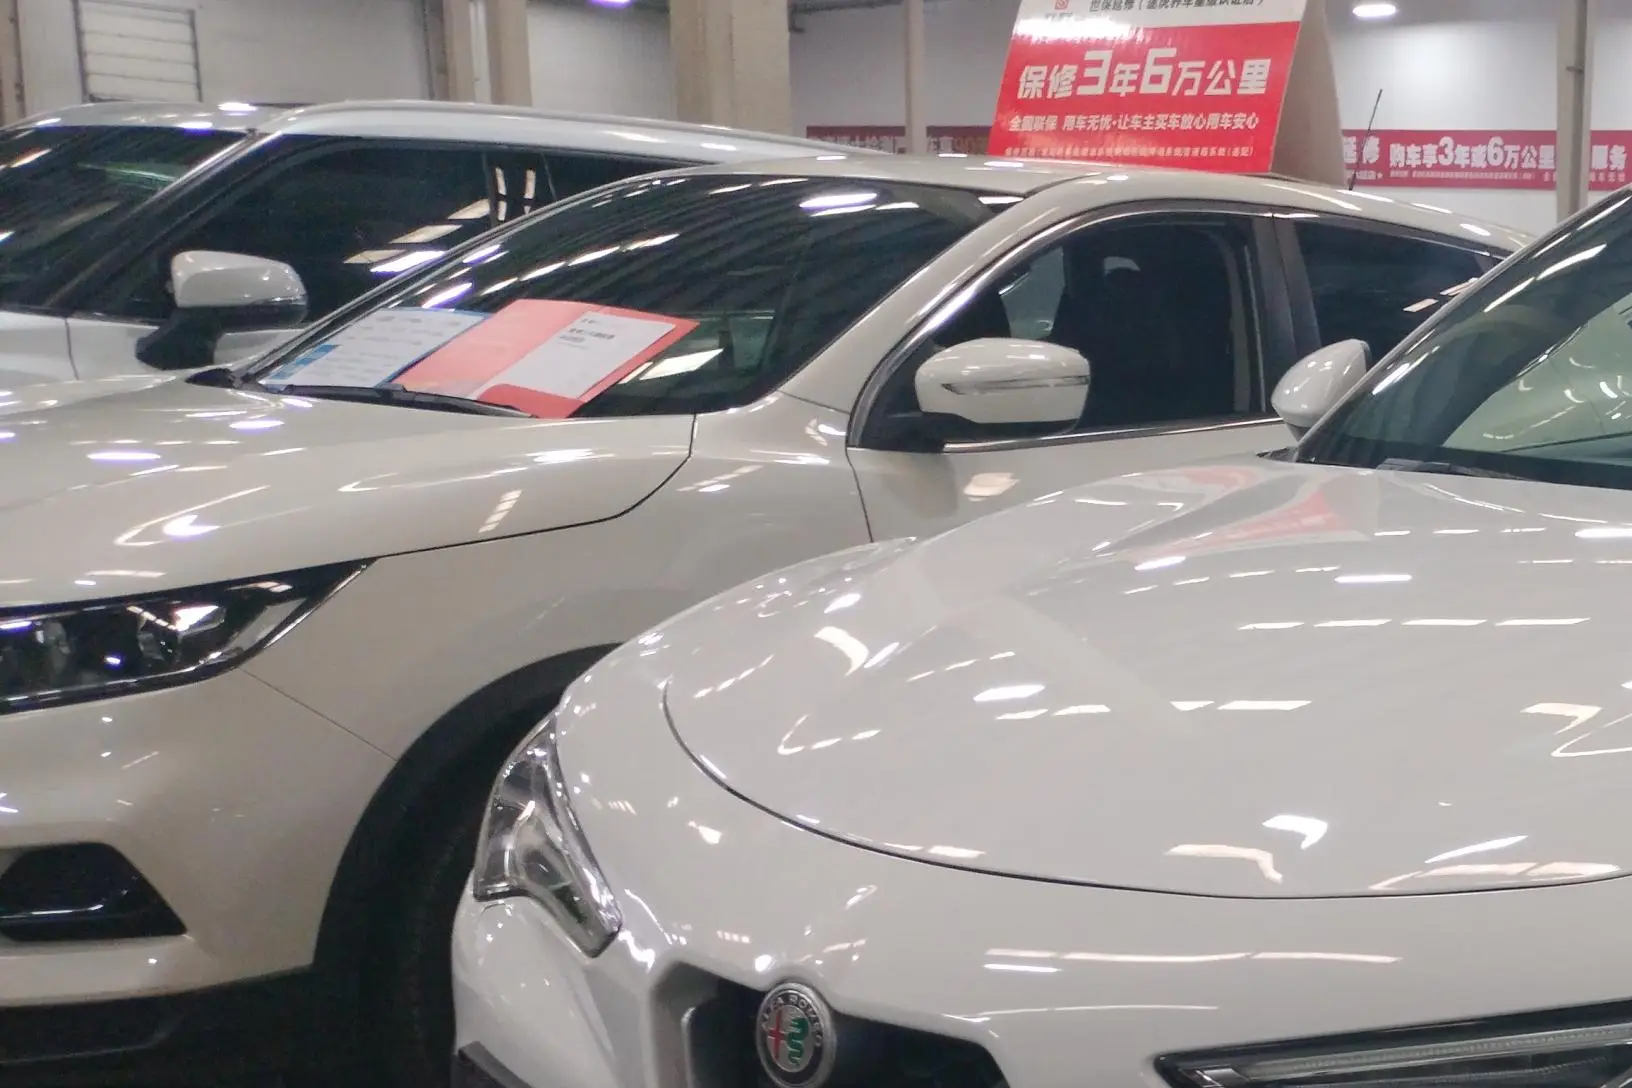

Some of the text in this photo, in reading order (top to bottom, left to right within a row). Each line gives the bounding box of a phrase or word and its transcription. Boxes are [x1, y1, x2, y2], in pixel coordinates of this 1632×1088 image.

[1017, 48, 1272, 100] 保修3年6万公里
